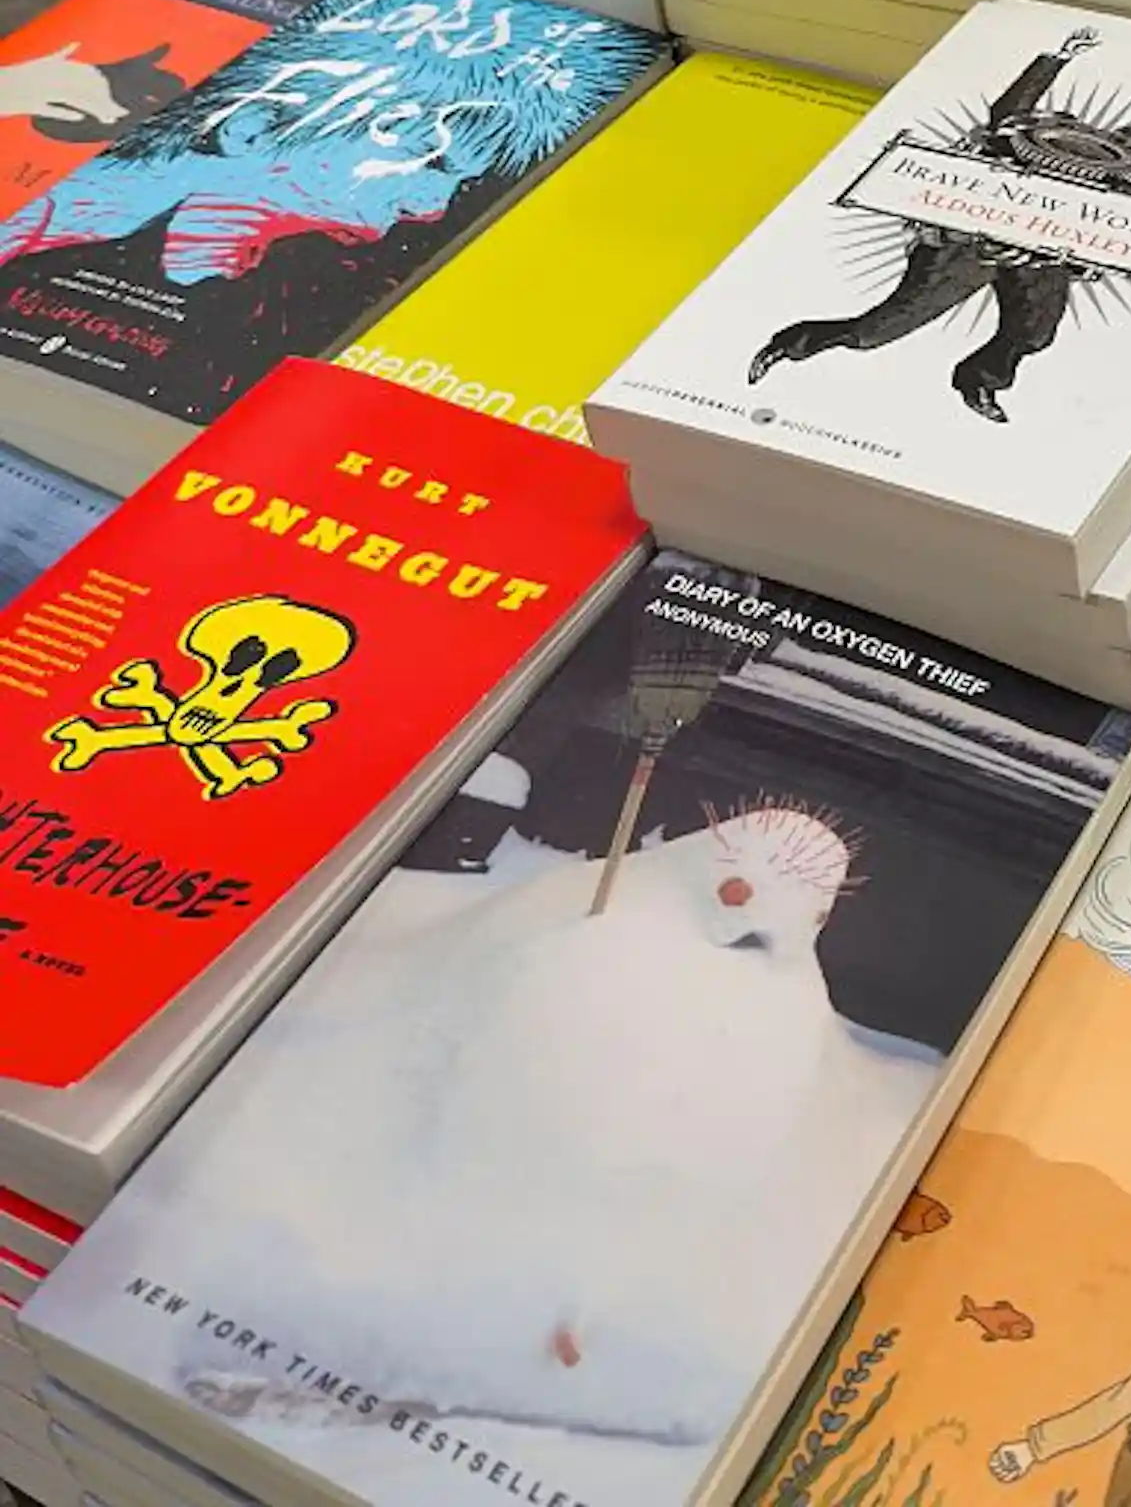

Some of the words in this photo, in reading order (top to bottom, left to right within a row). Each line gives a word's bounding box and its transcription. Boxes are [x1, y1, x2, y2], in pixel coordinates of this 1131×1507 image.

[198, 60, 500, 184] Flies
[892, 156, 983, 195] BRAVE
[994, 183, 1066, 214] NEW
[911, 187, 1021, 227] ALDOUS
[329, 343, 515, 420] stephen
[336, 451, 491, 515] KURT
[174, 471, 548, 611] VONNEGUT
[644, 598, 771, 650] ANONYMOUS
[663, 572, 738, 607] DIARY
[737, 596, 774, 621] OF
[772, 608, 810, 635] AN
[811, 619, 916, 672] OXYGEN
[914, 654, 992, 699] THIEF
[125, 1276, 189, 1316] NEW
[196, 1306, 276, 1362] YORK
[284, 1353, 380, 1415] TIMES
